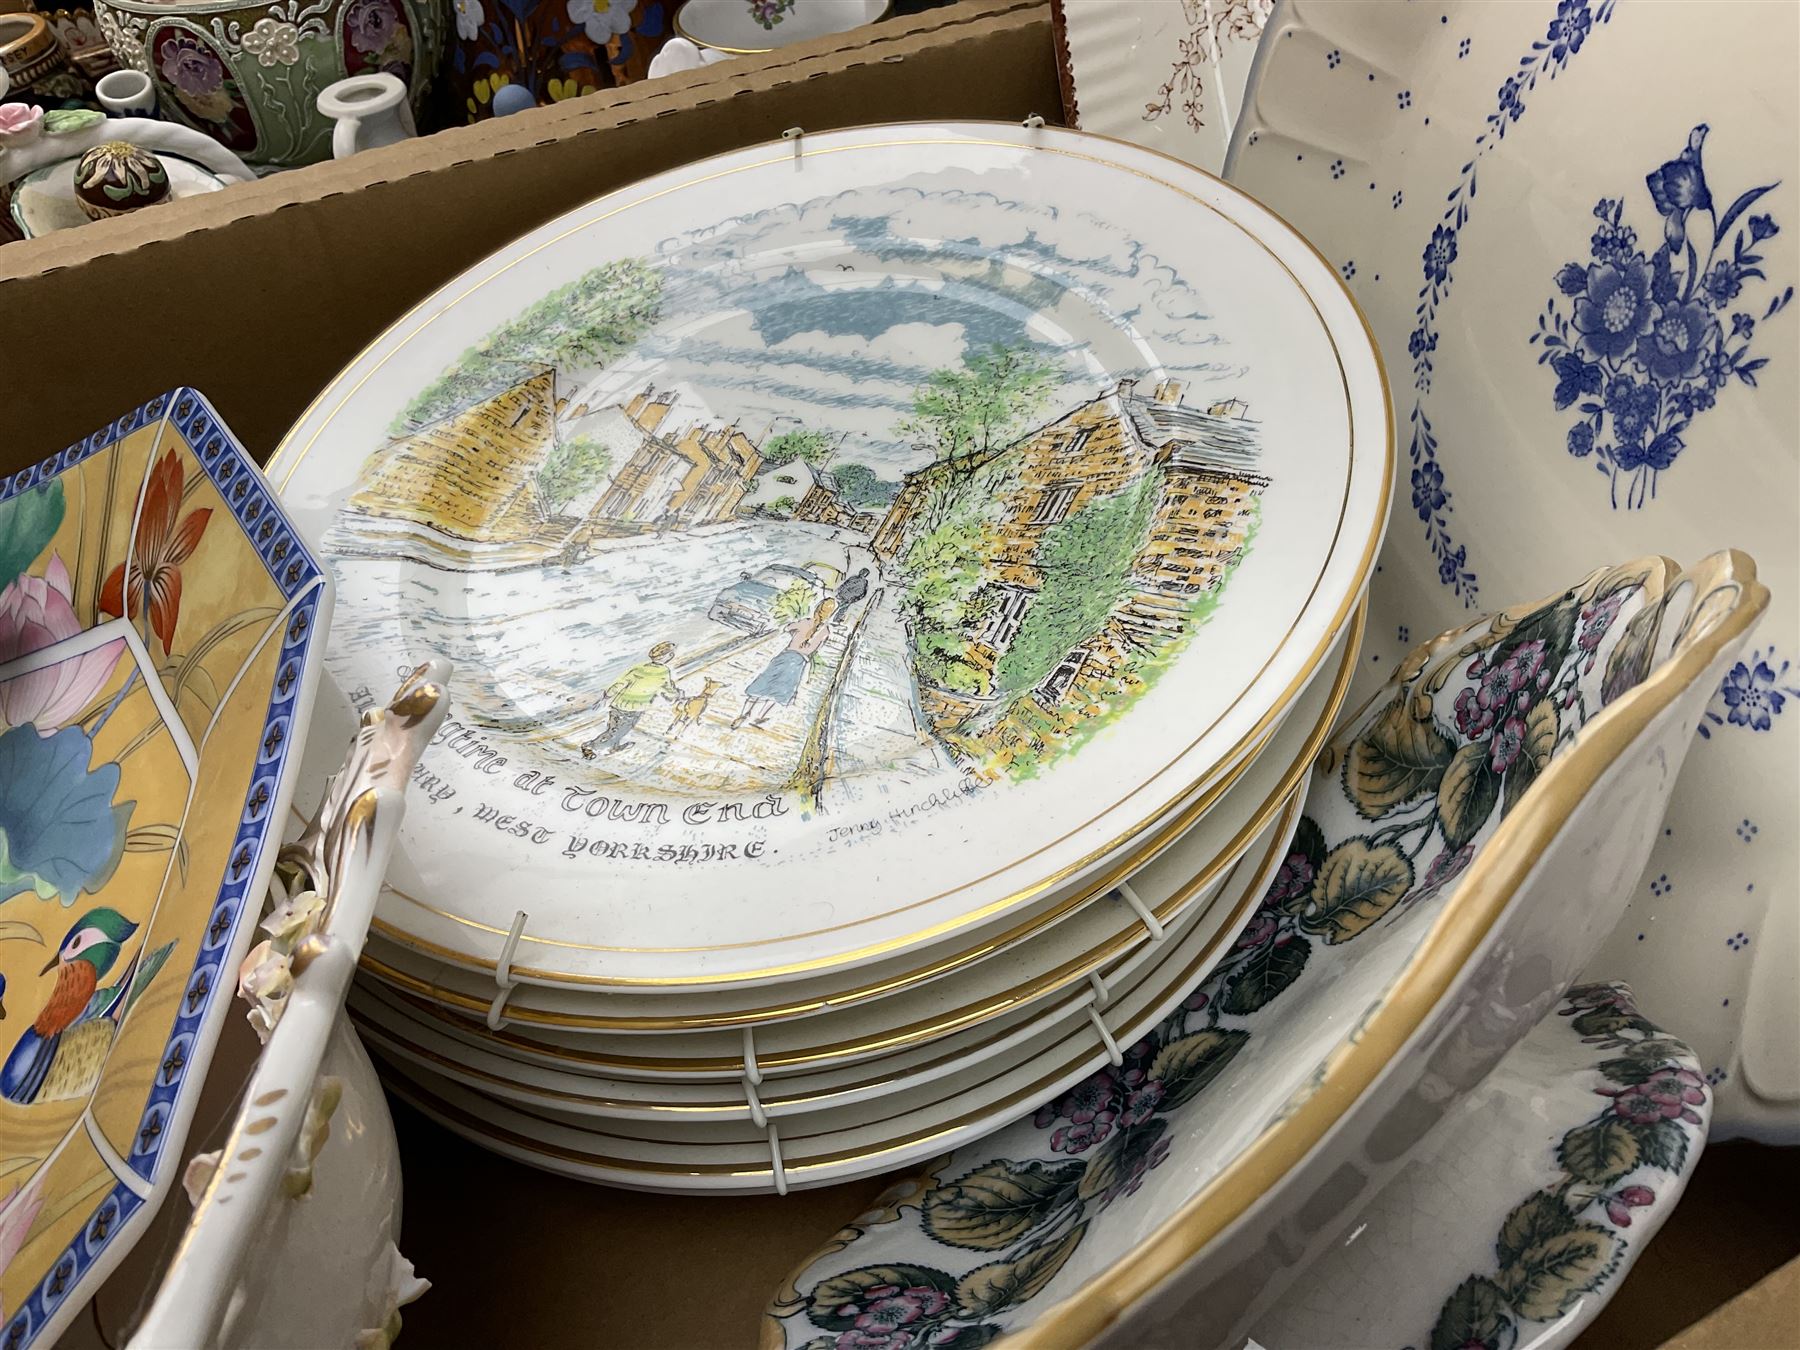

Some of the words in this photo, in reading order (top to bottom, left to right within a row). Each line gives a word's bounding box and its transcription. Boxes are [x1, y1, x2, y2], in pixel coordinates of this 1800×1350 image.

[513, 770, 556, 796] at
[561, 785, 671, 825] Town
[682, 793, 790, 826] End
[472, 803, 558, 845] WEST
